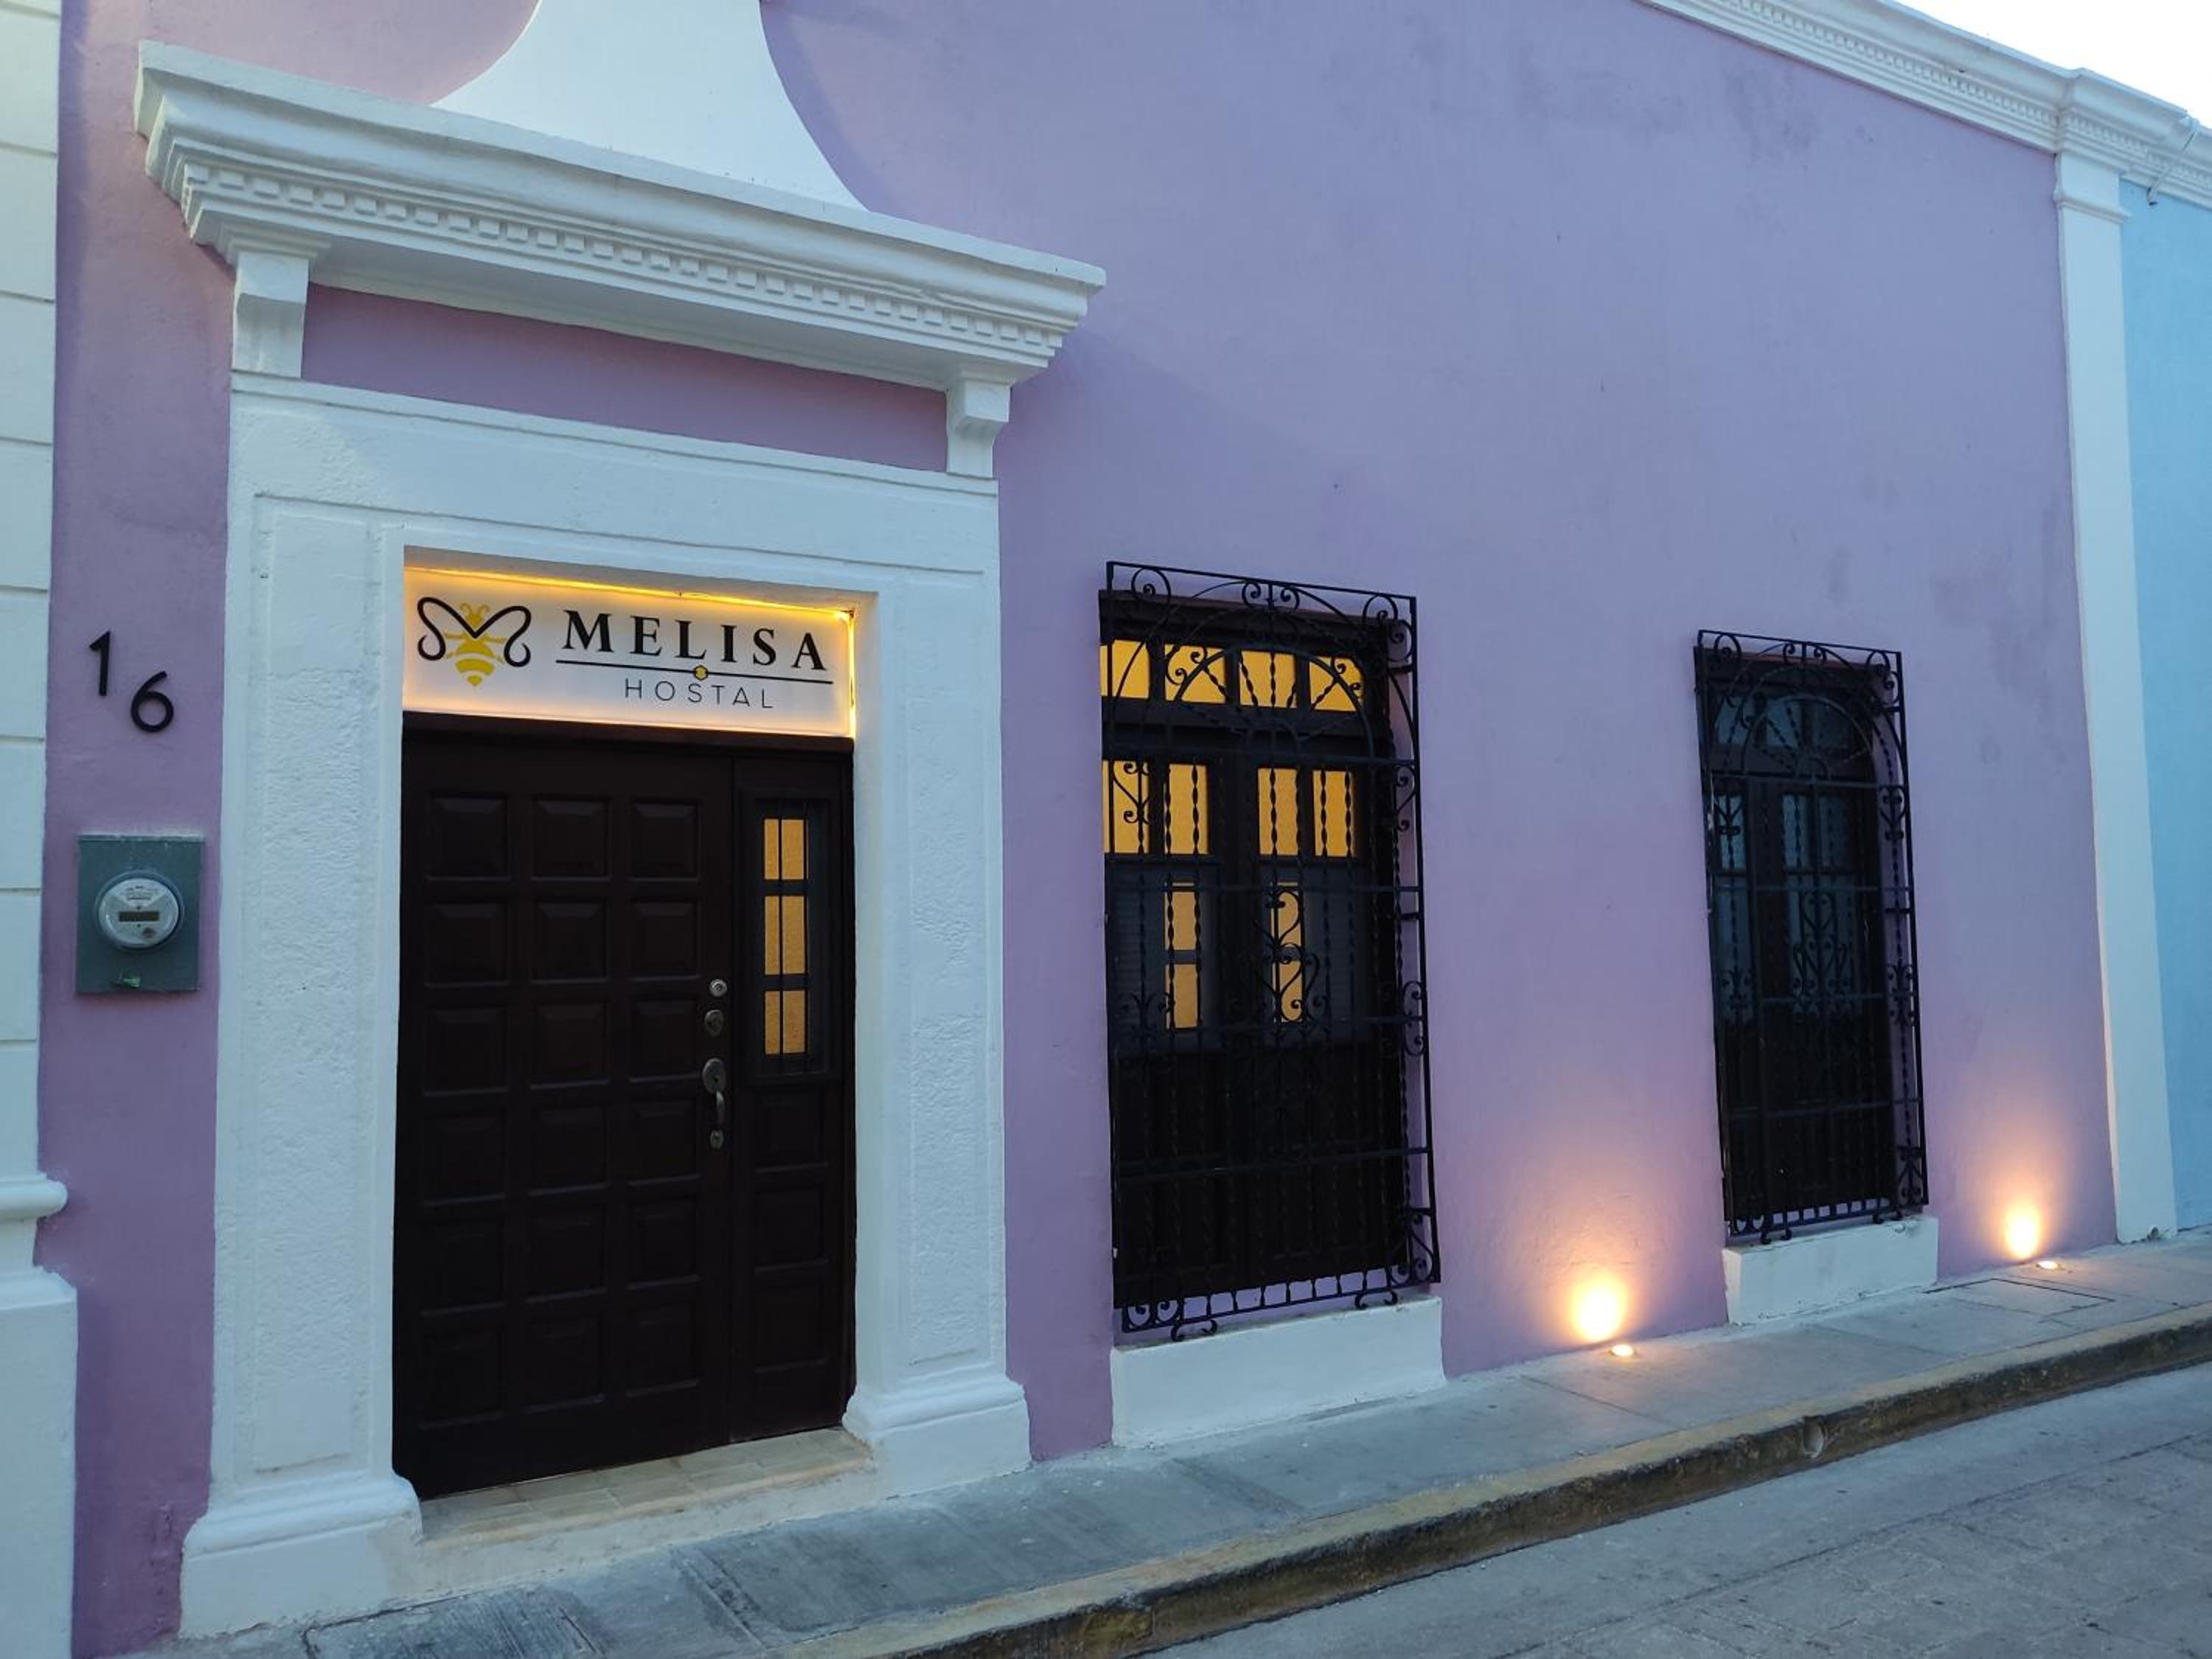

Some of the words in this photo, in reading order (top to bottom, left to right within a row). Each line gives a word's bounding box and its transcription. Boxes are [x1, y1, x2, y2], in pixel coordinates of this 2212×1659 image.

[561, 609, 827, 672] MELISA
[88, 630, 175, 734] 16
[624, 677, 774, 709] HOSTAL
